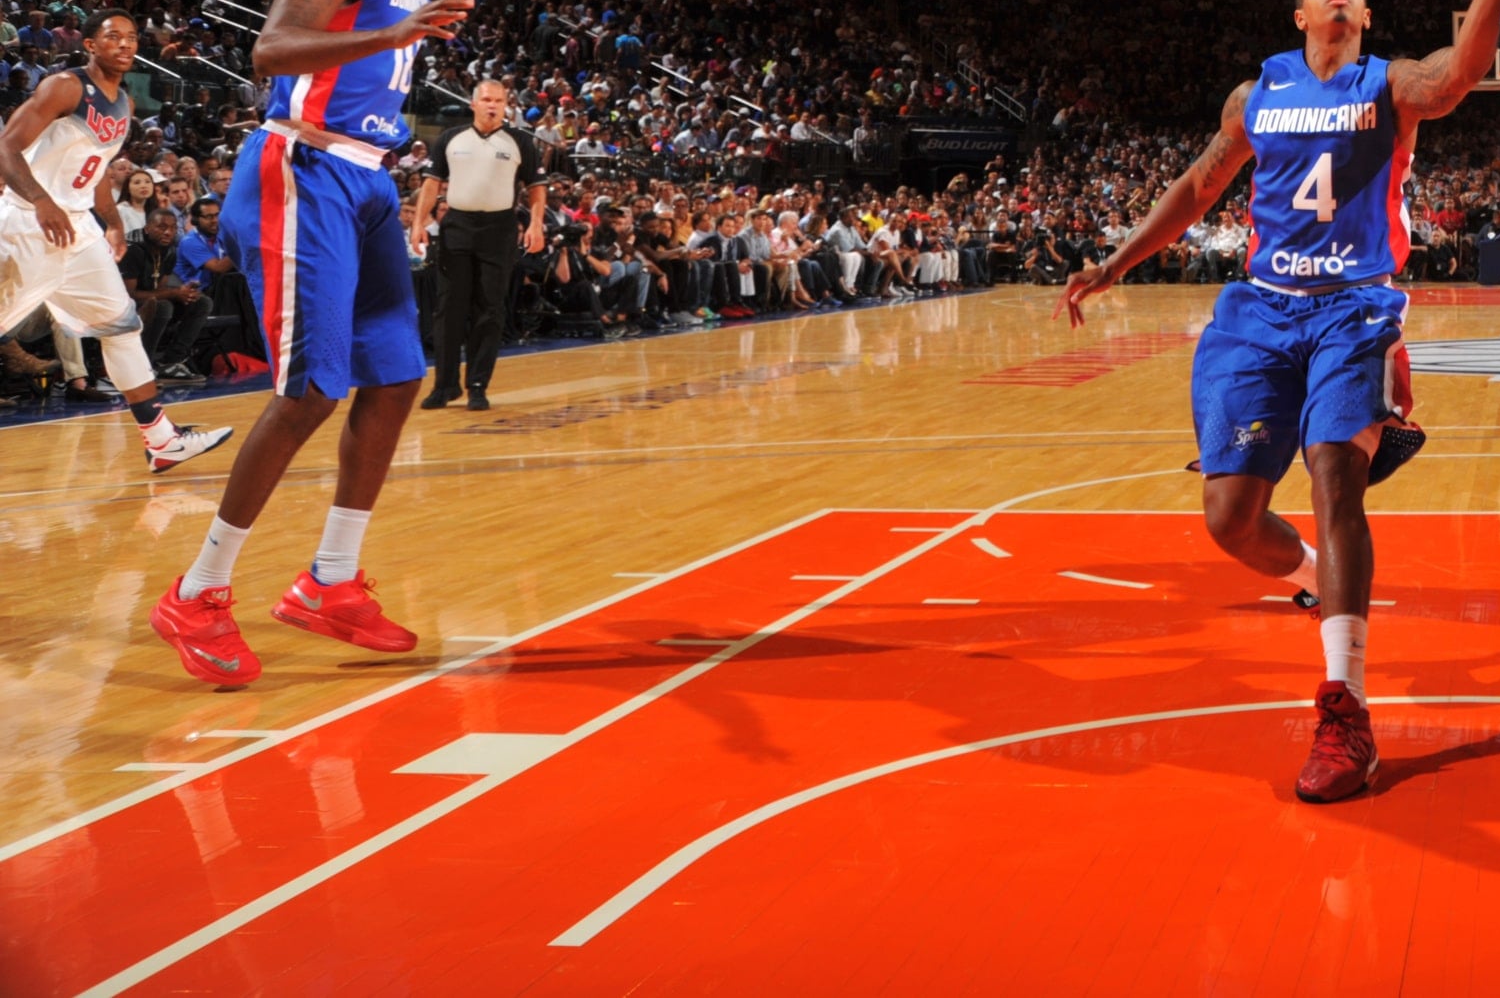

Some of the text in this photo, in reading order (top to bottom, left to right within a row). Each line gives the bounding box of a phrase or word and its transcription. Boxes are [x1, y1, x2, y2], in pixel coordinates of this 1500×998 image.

[86, 104, 129, 143] USA
[1253, 102, 1377, 134] DOMINICANA
[72, 155, 101, 189] 9
[1292, 152, 1337, 223] 4
